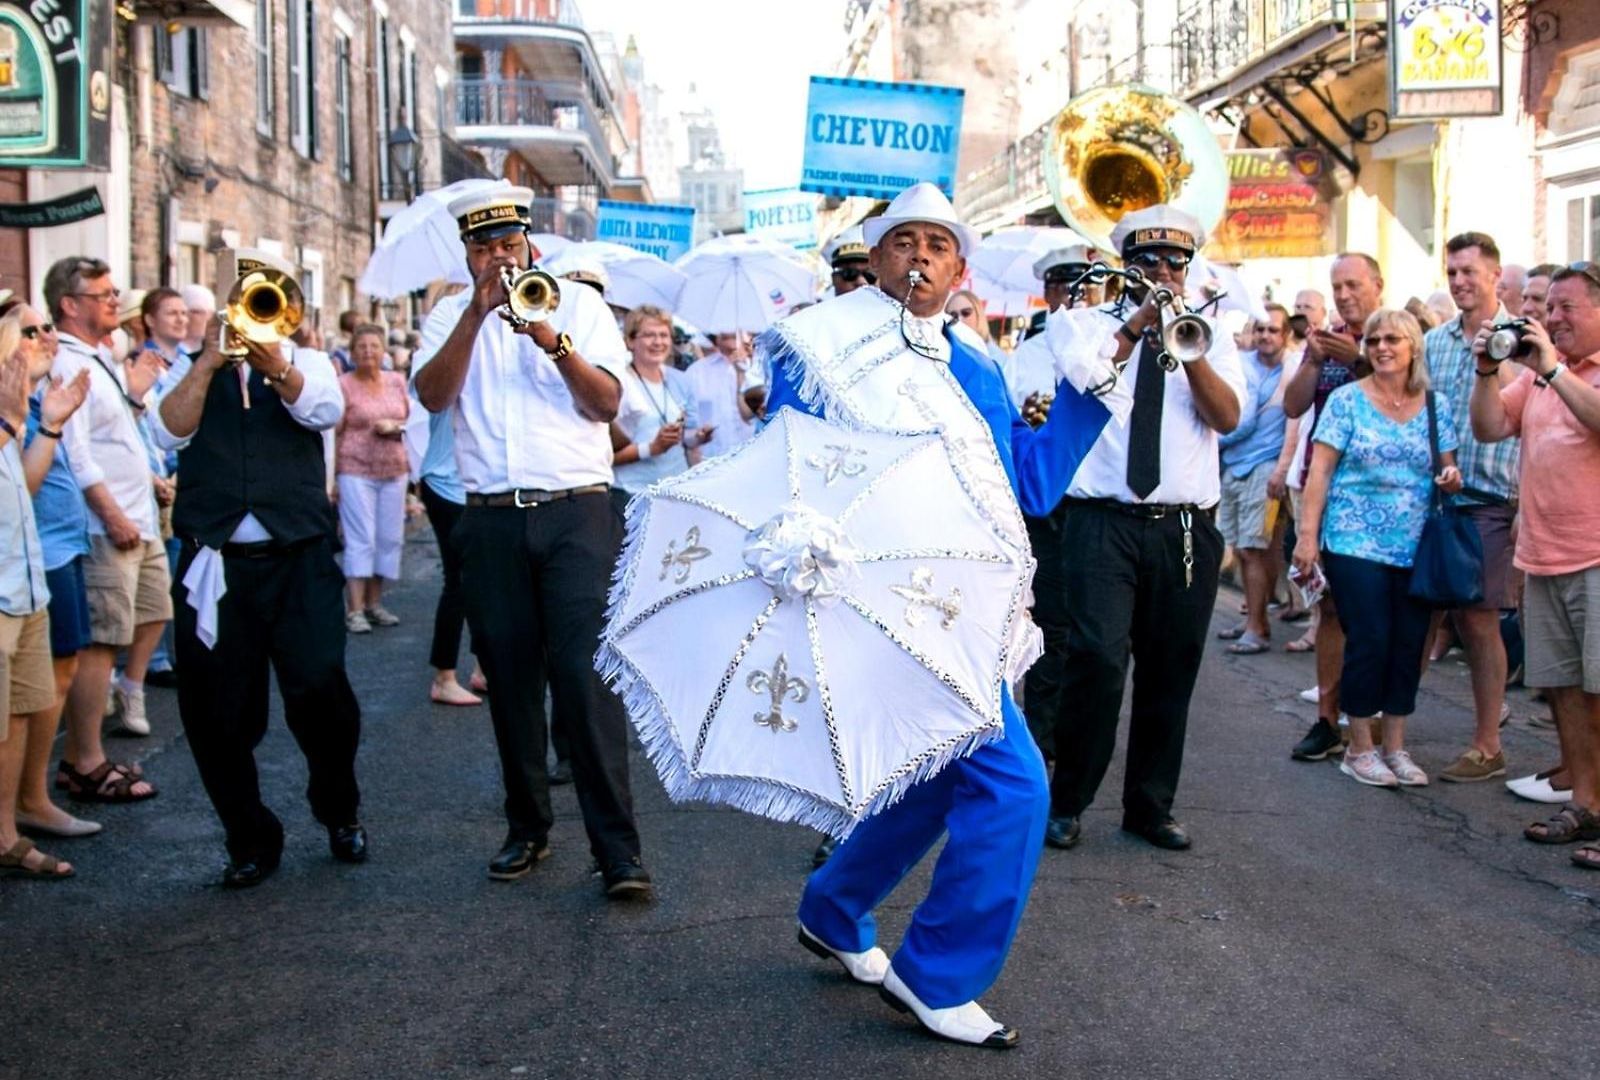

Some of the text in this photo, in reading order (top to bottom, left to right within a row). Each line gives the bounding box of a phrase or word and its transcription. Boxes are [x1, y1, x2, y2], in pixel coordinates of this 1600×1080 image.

[812, 113, 954, 153] CHEVRON
[1226, 153, 1290, 178] illie's
[748, 202, 812, 229] POPEYES
